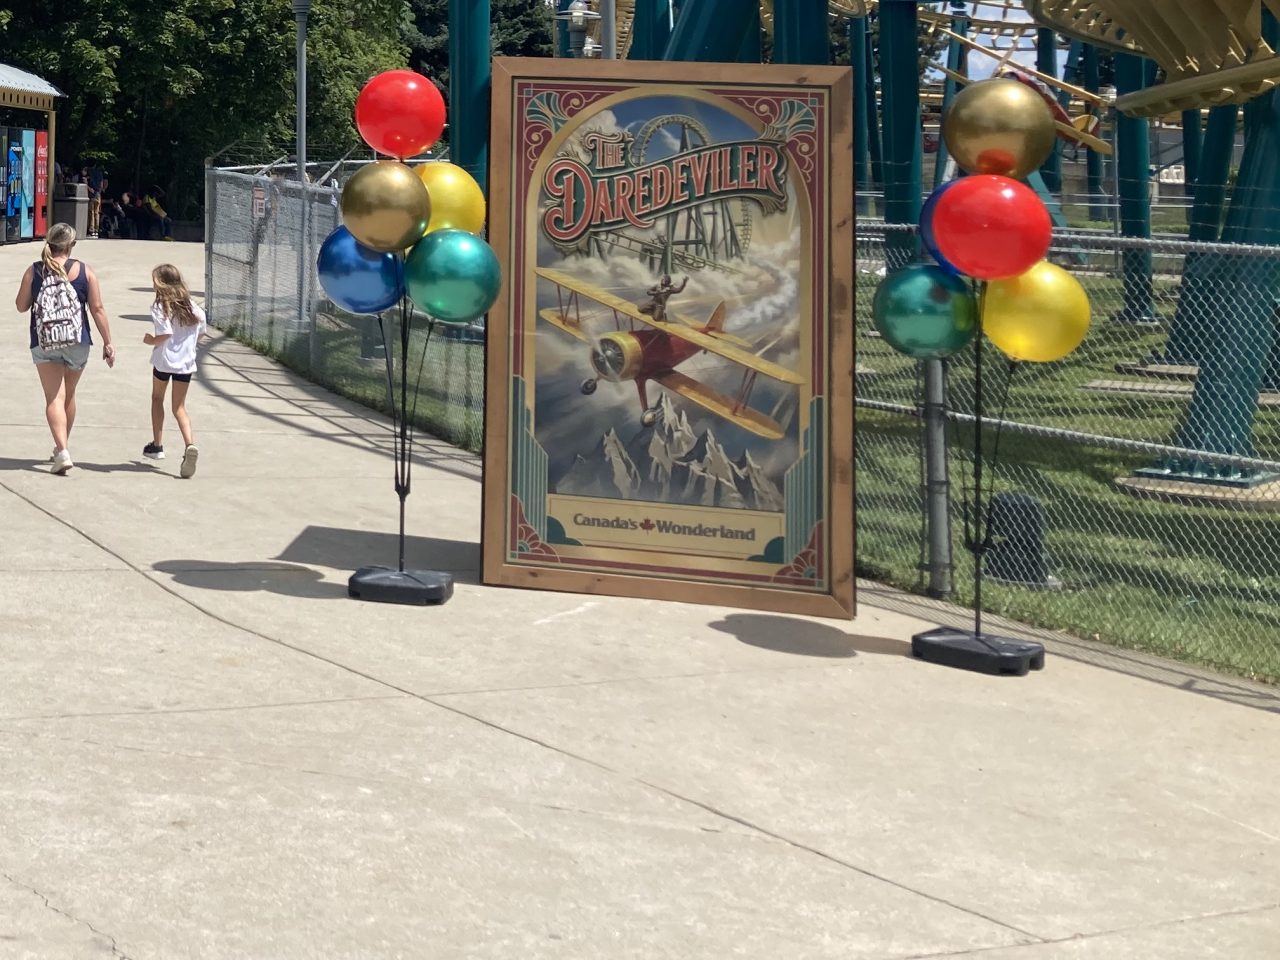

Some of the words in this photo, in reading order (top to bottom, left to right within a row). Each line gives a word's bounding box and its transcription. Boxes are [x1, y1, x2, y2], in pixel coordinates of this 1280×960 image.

[585, 133, 625, 168] THE
[545, 145, 783, 240] DAREDEVILER
[573, 514, 638, 531] Canada's
[656, 520, 756, 541] Wonderland
